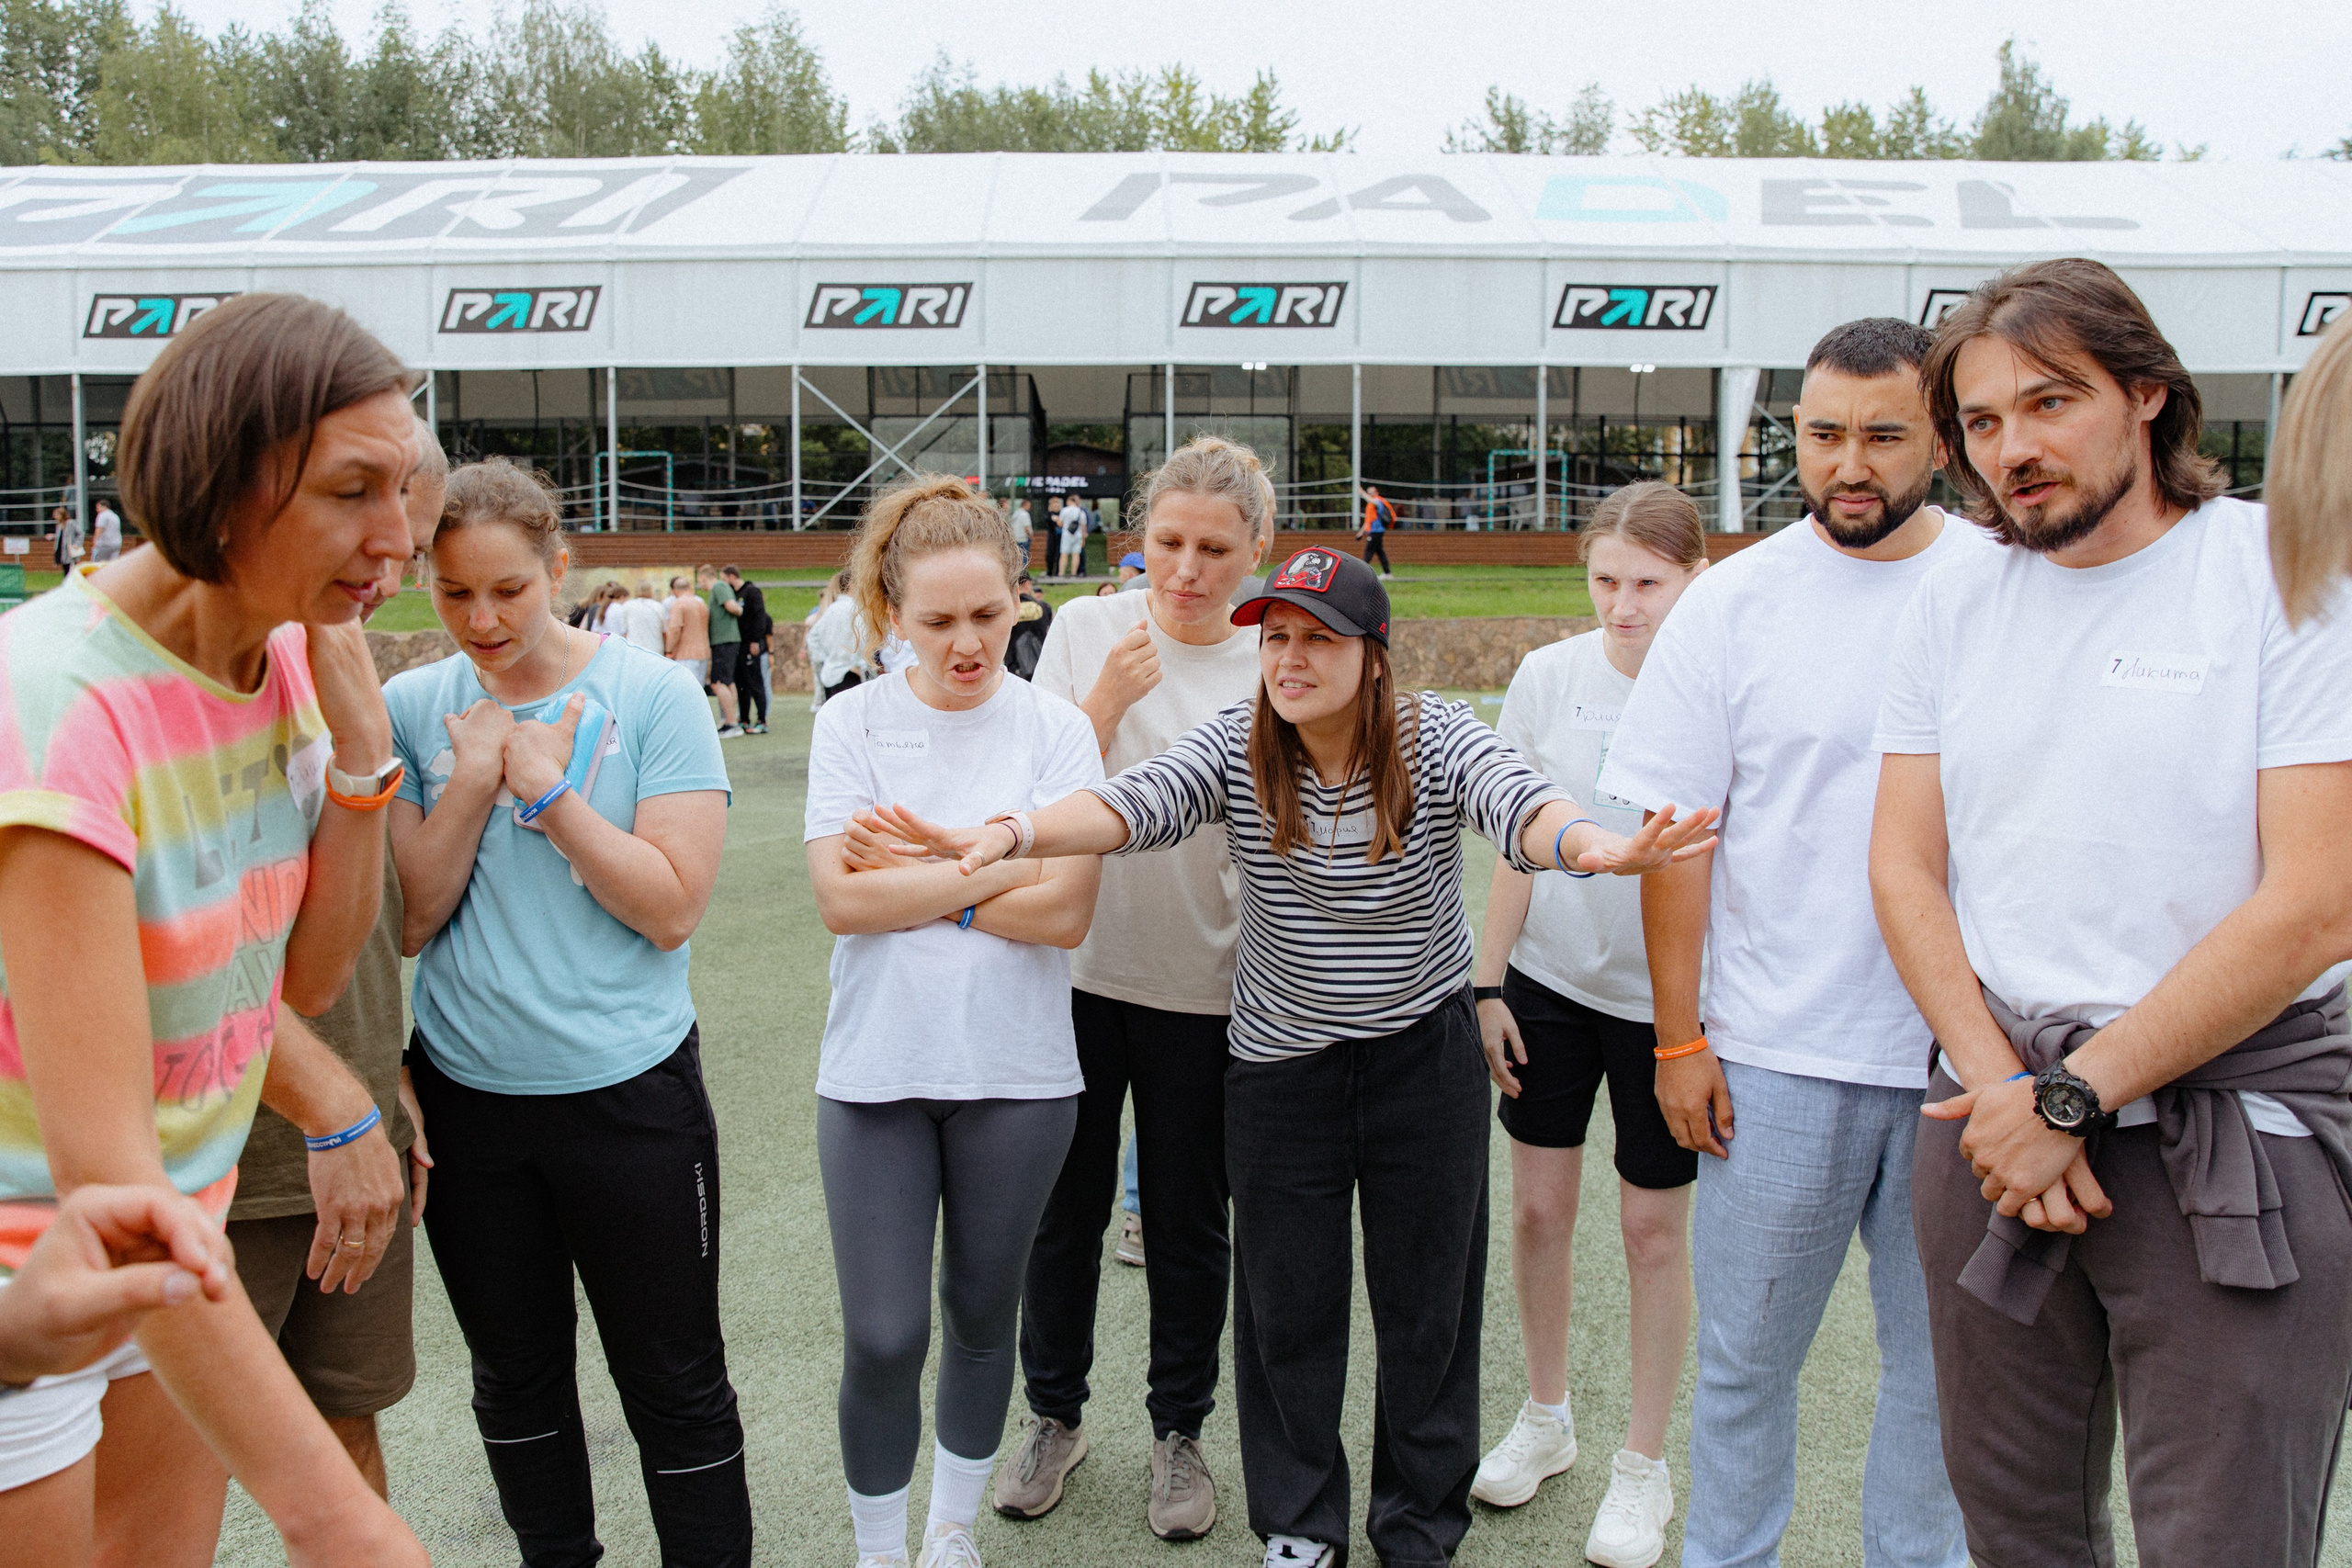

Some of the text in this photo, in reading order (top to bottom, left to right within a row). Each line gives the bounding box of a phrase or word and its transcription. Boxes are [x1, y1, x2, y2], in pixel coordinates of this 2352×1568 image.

[1079, 172, 2141, 230] PADEL
[89, 297, 232, 334] PAR
[445, 289, 594, 329] PARI
[811, 286, 965, 325] PARI
[1186, 286, 1340, 324] PARI
[1558, 288, 1711, 327] PARI
[2112, 659, 2122, 673] 7
[1577, 706, 1581, 717] 7
[695, 1162, 708, 1258] NORDSKI
